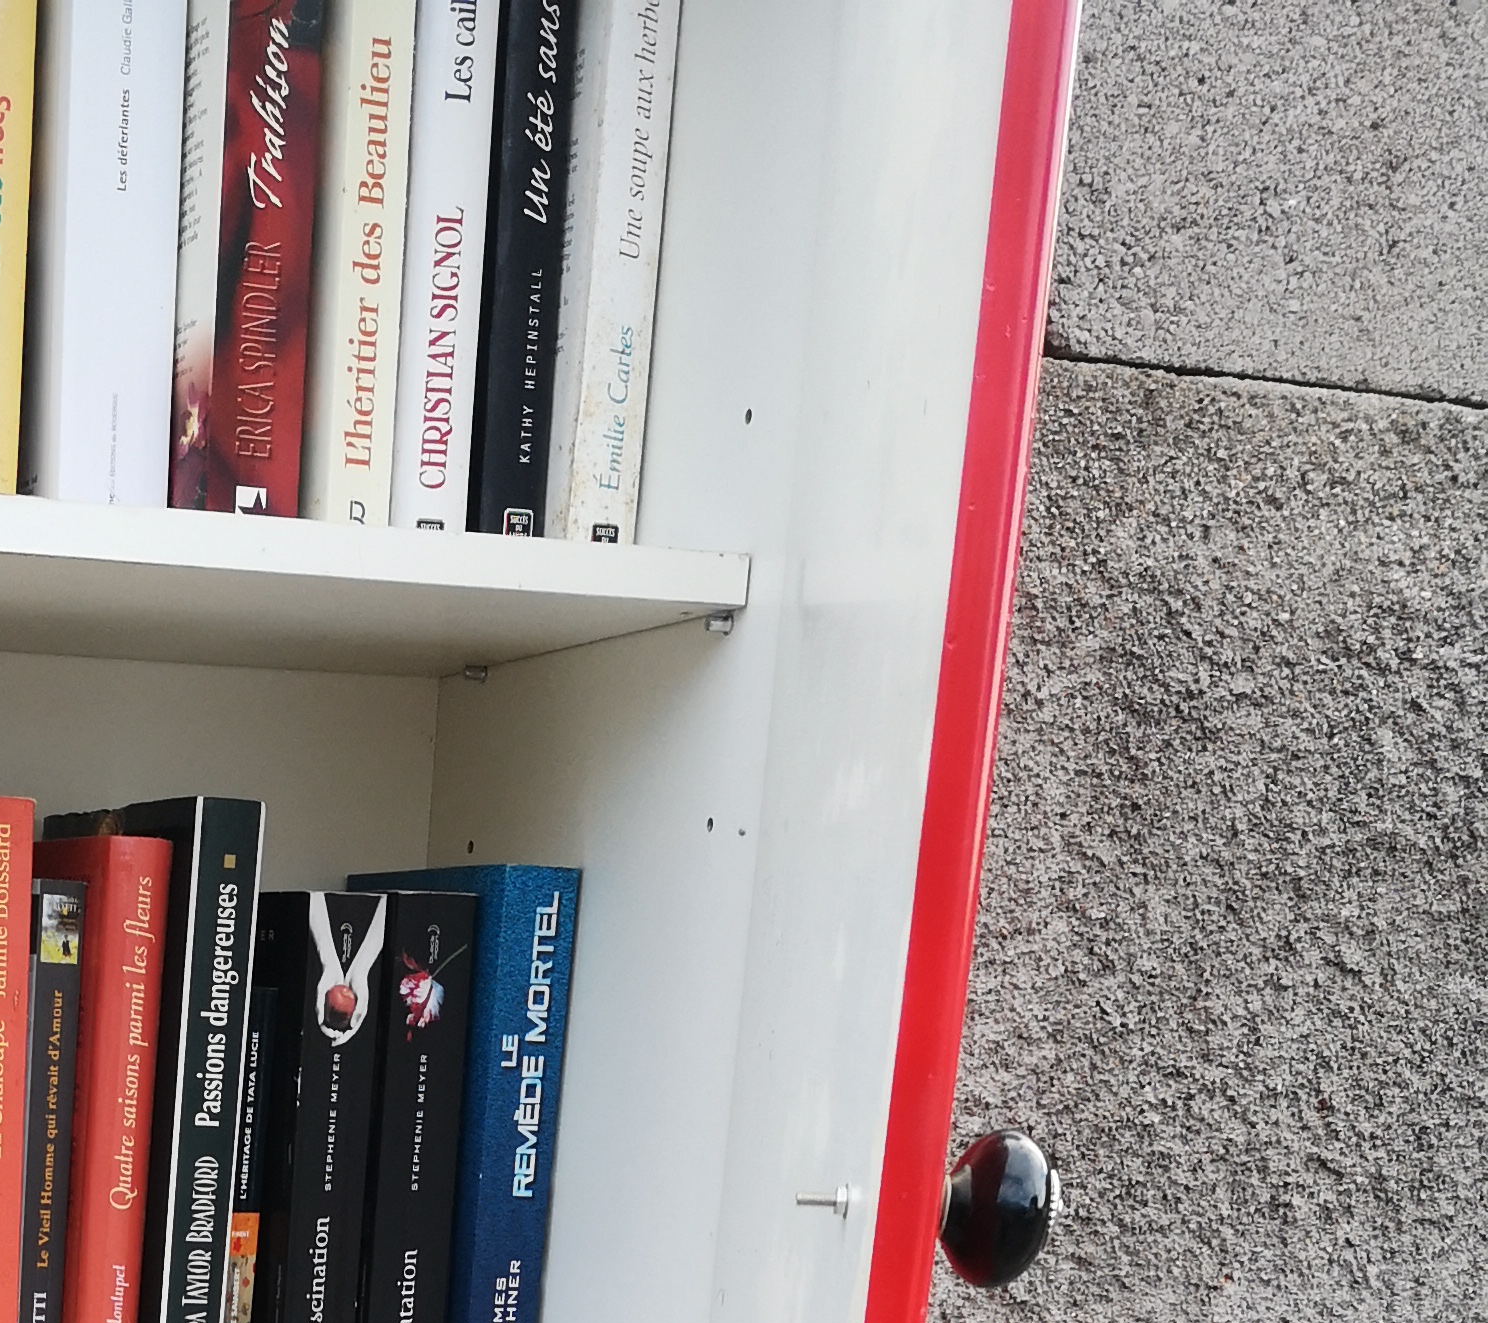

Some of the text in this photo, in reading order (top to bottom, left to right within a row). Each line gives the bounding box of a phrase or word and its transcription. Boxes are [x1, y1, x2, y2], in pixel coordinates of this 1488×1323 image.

[116, 28, 133, 166] déferlantes Claudie
[444, 55, 474, 104] Les
[634, 69, 654, 121] aux
[356, 36, 393, 210] Beaulieu
[626, 127, 653, 202] soupe
[234, 15, 290, 458] ERICA SPINDLER Trahison
[351, 221, 384, 285] des
[429, 206, 465, 322] SIGNOL
[518, 0, 560, 464] KATHY HEPINSTALL Un été sans
[618, 208, 644, 261] Une
[342, 297, 380, 471] L'héritier
[607, 324, 635, 406] Carles
[418, 328, 457, 490] CHRISTIAN
[592, 414, 626, 492] Émilie
[200, 882, 240, 1028] dangereuses
[109, 875, 155, 1210] Quatre saisons parmi les fleurs
[194, 1032, 228, 1127] Passions
[329, 1053, 341, 1103] MEYER
[416, 1054, 427, 1103] MEYER
[499, 1034, 519, 1068] LE
[511, 890, 560, 1198] REMÈDE MORTEL
[324, 1109, 337, 1192] STEPHENIE
[411, 1110, 424, 1192] STEPHENIE
[184, 1155, 220, 1243] BRADFORD
[181, 1249, 213, 1307] TAYLOR
